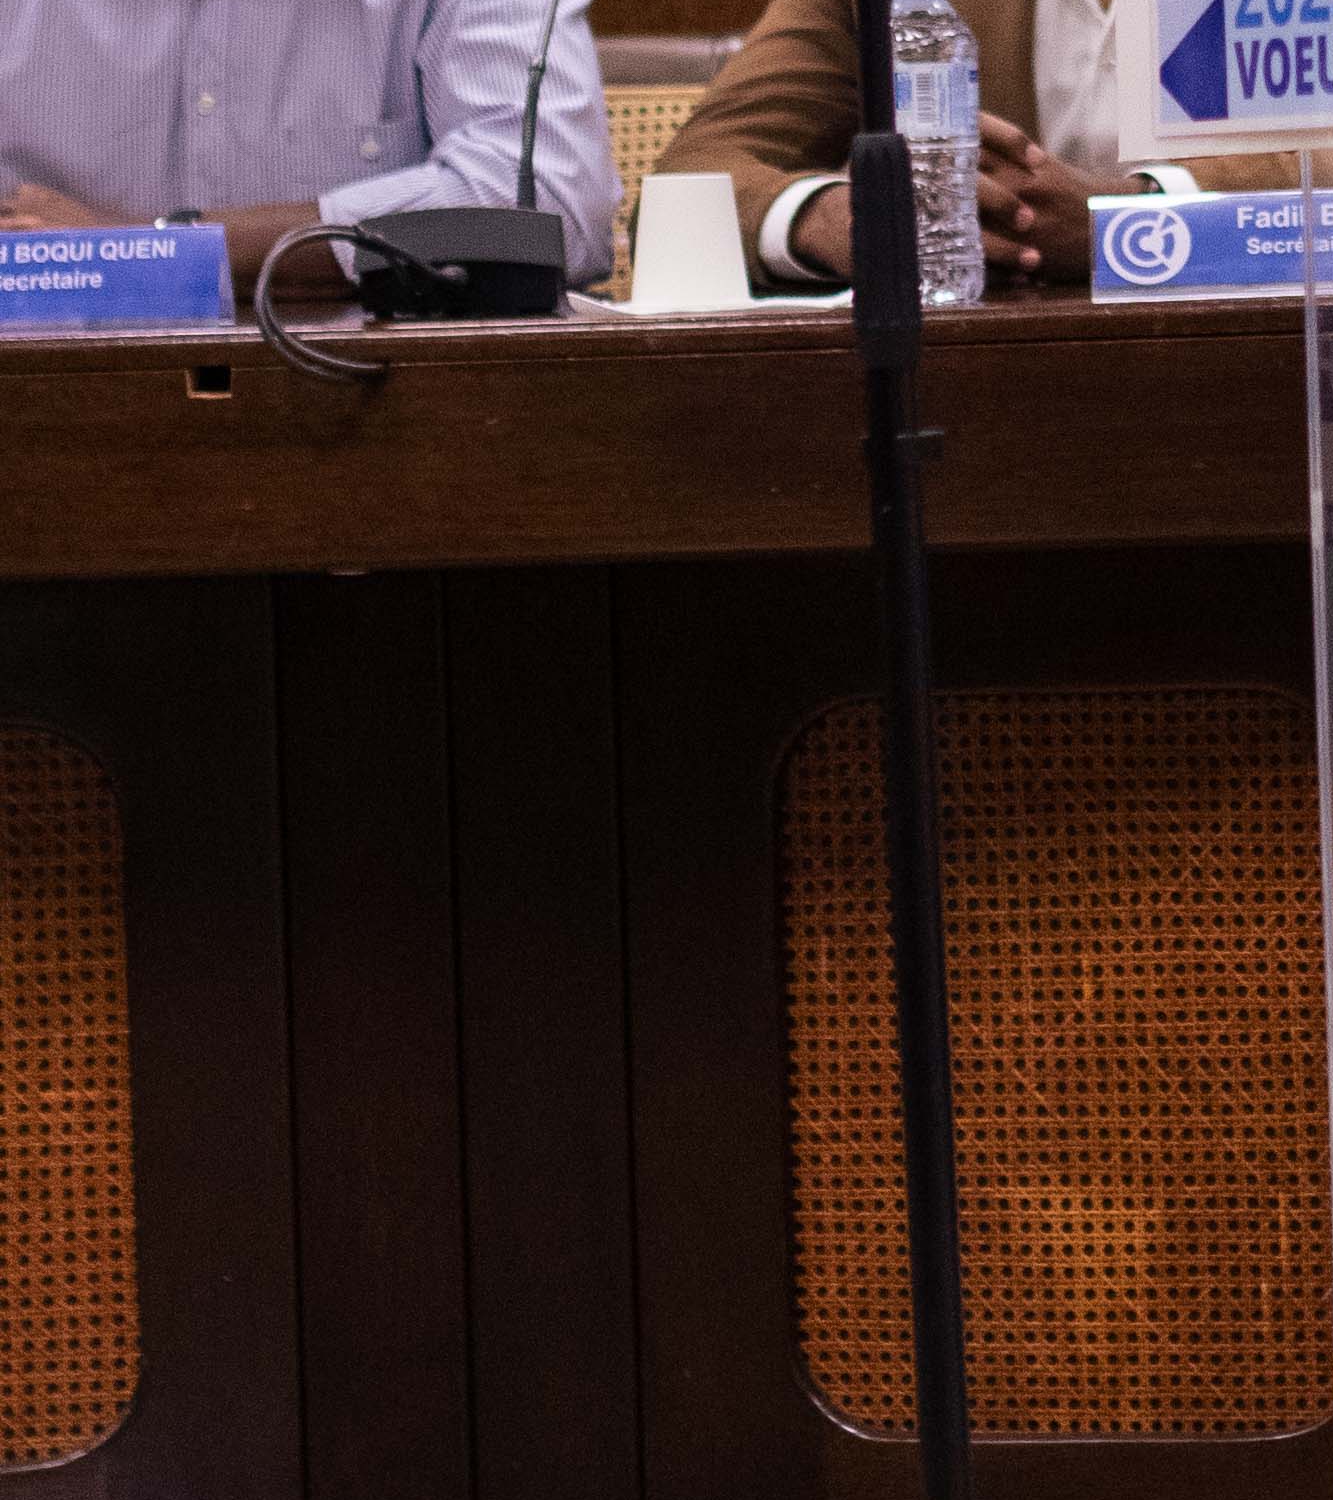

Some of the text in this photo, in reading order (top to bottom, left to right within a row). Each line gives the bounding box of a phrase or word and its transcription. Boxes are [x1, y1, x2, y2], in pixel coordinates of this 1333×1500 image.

[1236, 205, 1304, 230] Fadil
[14, 241, 93, 265] BOQUI
[100, 238, 176, 262] QUENI
[0, 269, 103, 292] ecrétaire
